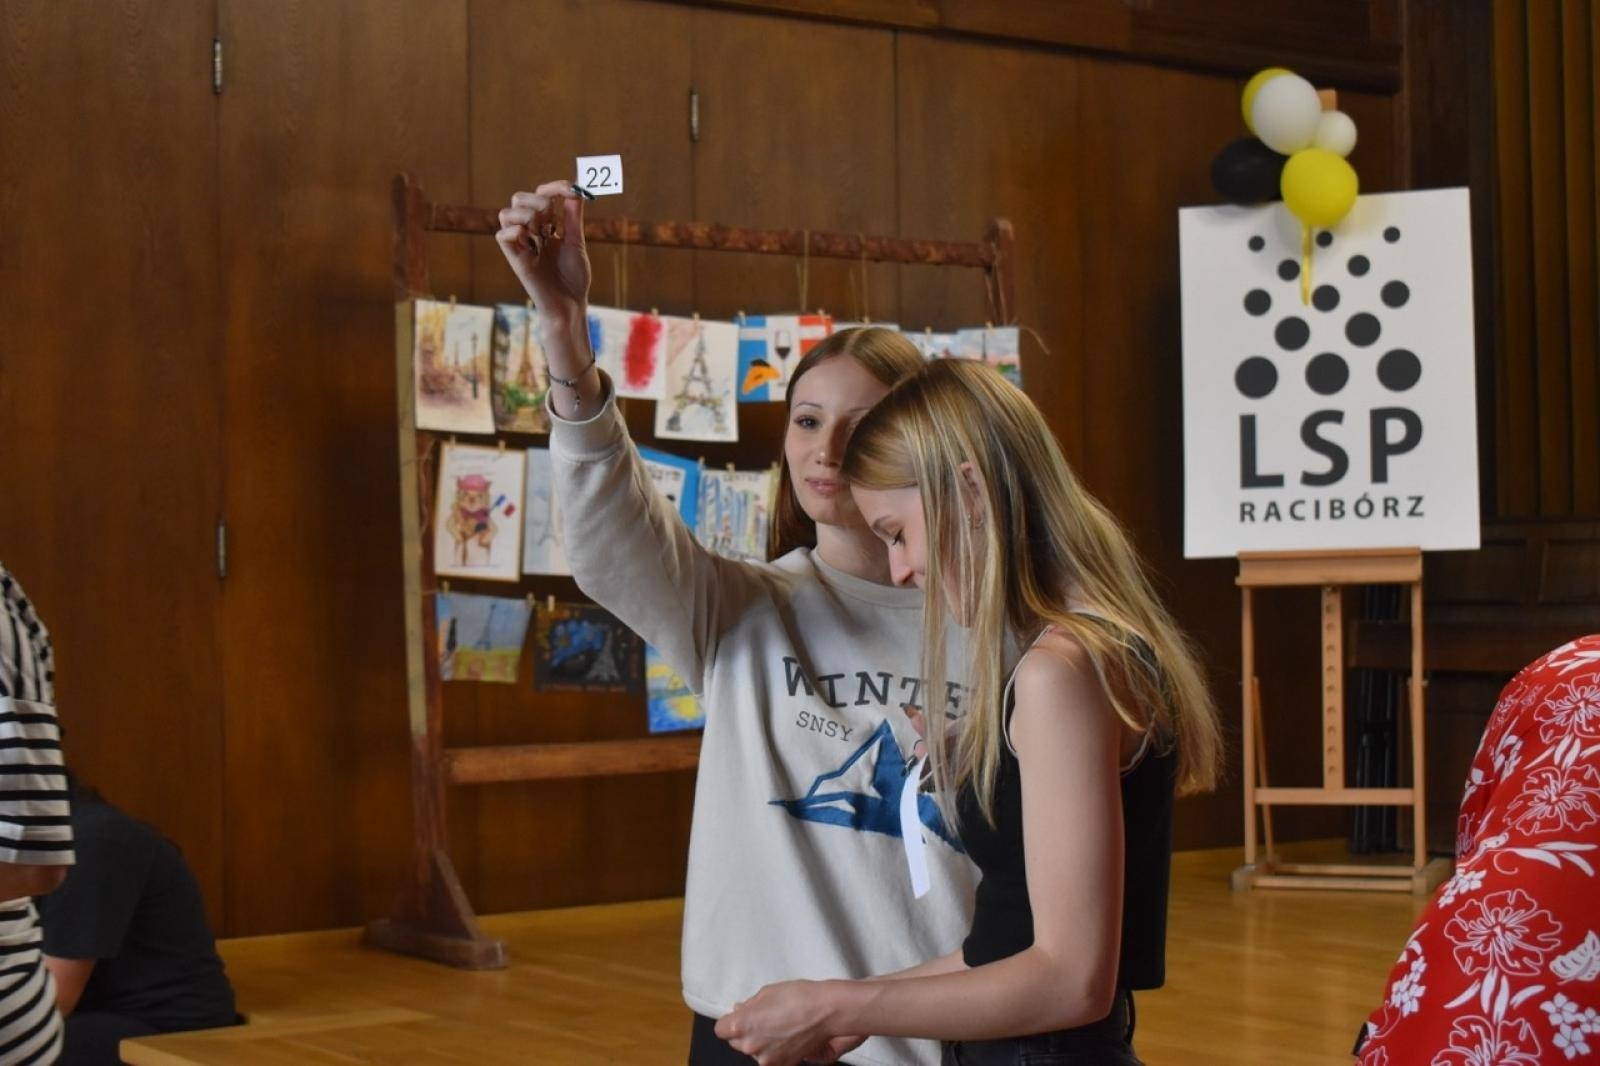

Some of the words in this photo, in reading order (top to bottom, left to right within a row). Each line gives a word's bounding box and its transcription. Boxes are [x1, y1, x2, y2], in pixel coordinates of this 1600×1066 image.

[586, 166, 619, 188] 22.
[1239, 406, 1423, 490] LSP
[1239, 493, 1425, 523] RACIBÓRZ
[782, 656, 972, 720] WINTE
[795, 710, 853, 742] SNSY
